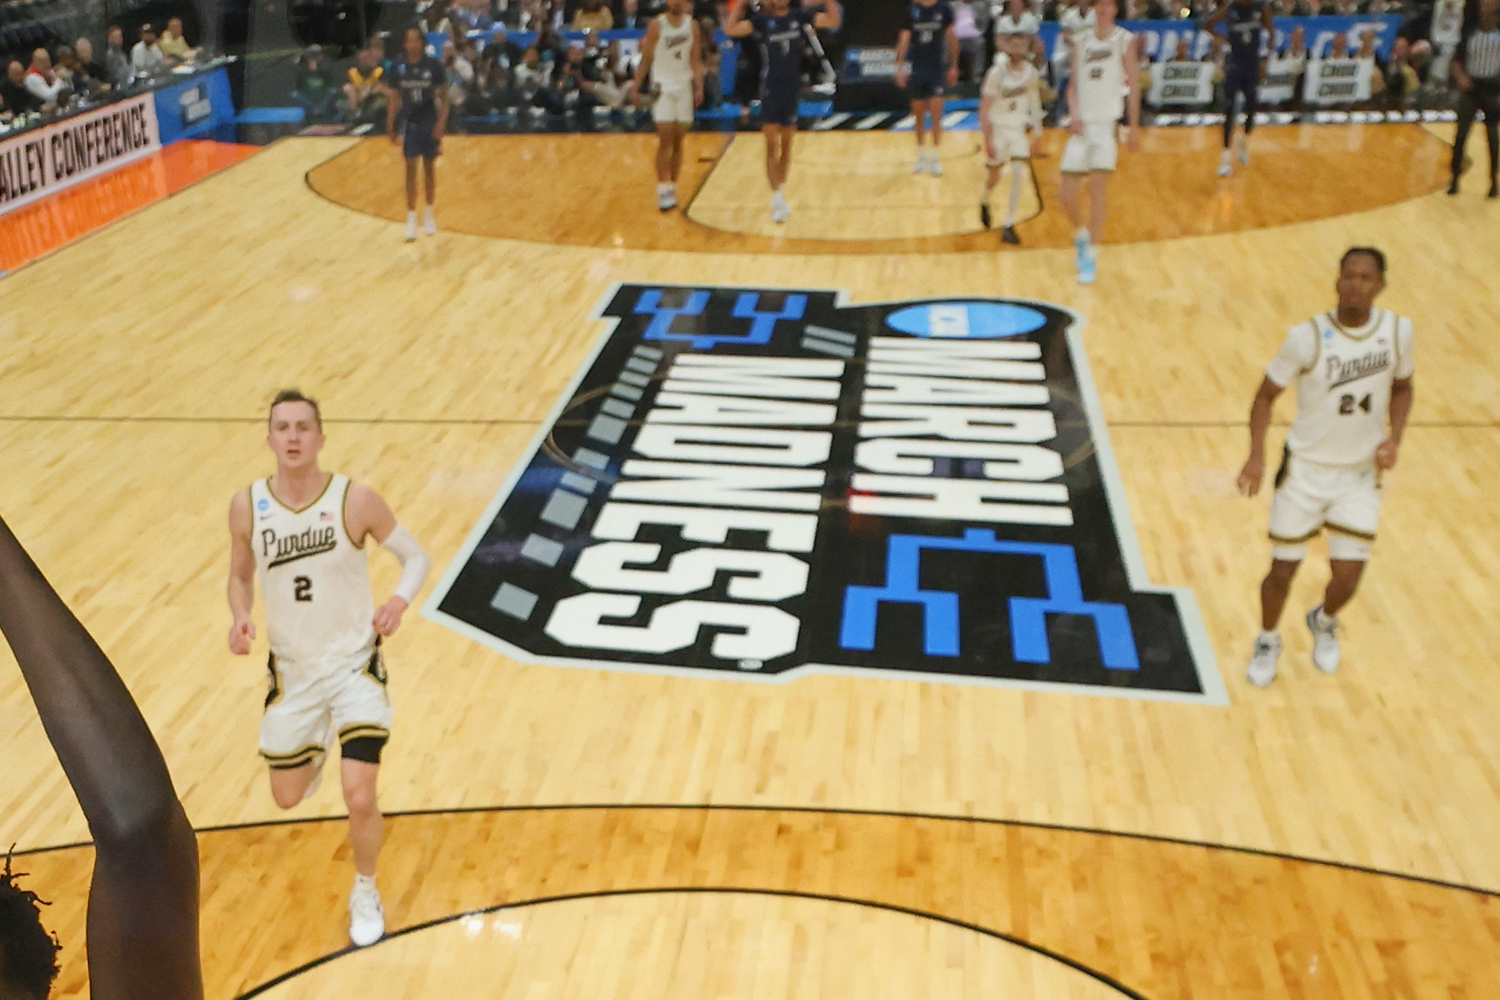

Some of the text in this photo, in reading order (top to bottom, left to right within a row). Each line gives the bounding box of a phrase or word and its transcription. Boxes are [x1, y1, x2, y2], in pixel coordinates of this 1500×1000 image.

[50, 101, 151, 180] CONFERENCE
[1326, 349, 1390, 385] Purdue
[1338, 392, 1373, 416] 24
[848, 335, 1074, 526] MARCH
[544, 352, 846, 662] MADNESS
[261, 525, 338, 563] Purdue
[293, 575, 313, 602] 2
